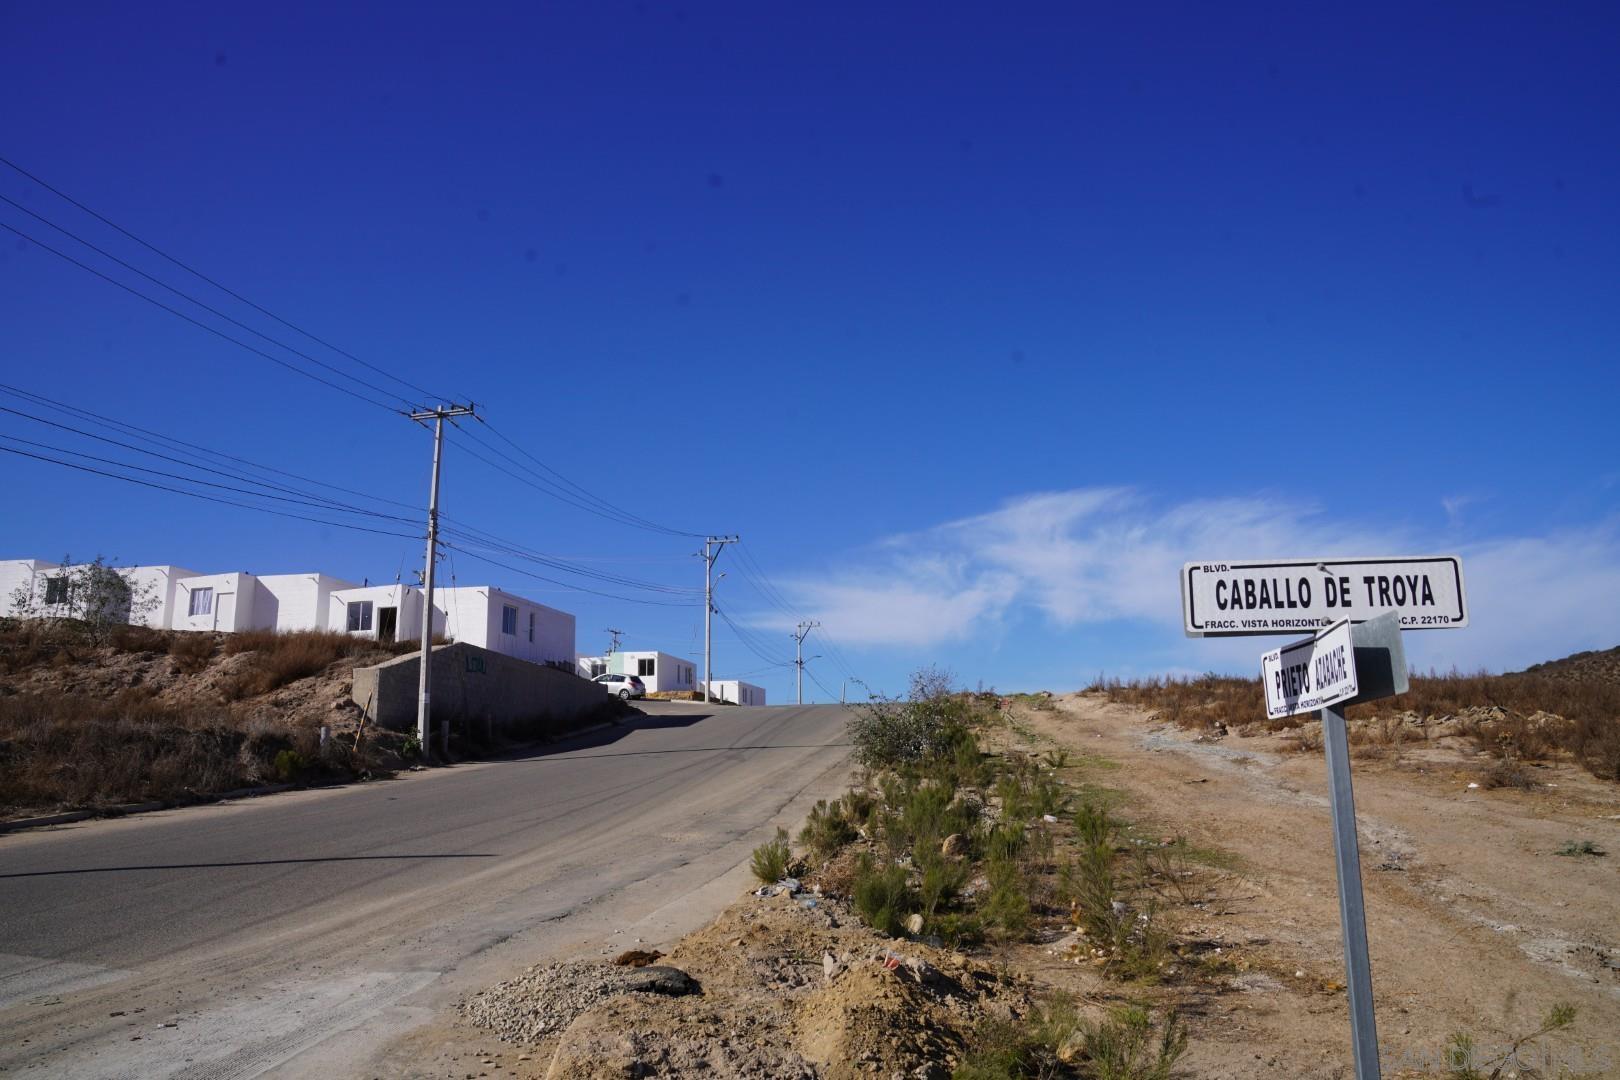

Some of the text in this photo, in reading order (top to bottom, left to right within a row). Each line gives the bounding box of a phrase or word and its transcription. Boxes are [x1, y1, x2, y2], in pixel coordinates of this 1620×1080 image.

[1203, 565, 1230, 573] BLVD.
[1216, 574, 1435, 610] CABALLO DE TROYA
[1205, 620, 1239, 629] FRACC.
[1242, 619, 1270, 628] VISTA
[1402, 615, 1449, 624] C.P. 22170
[1275, 645, 1347, 700] PRIETO AZABACHE
